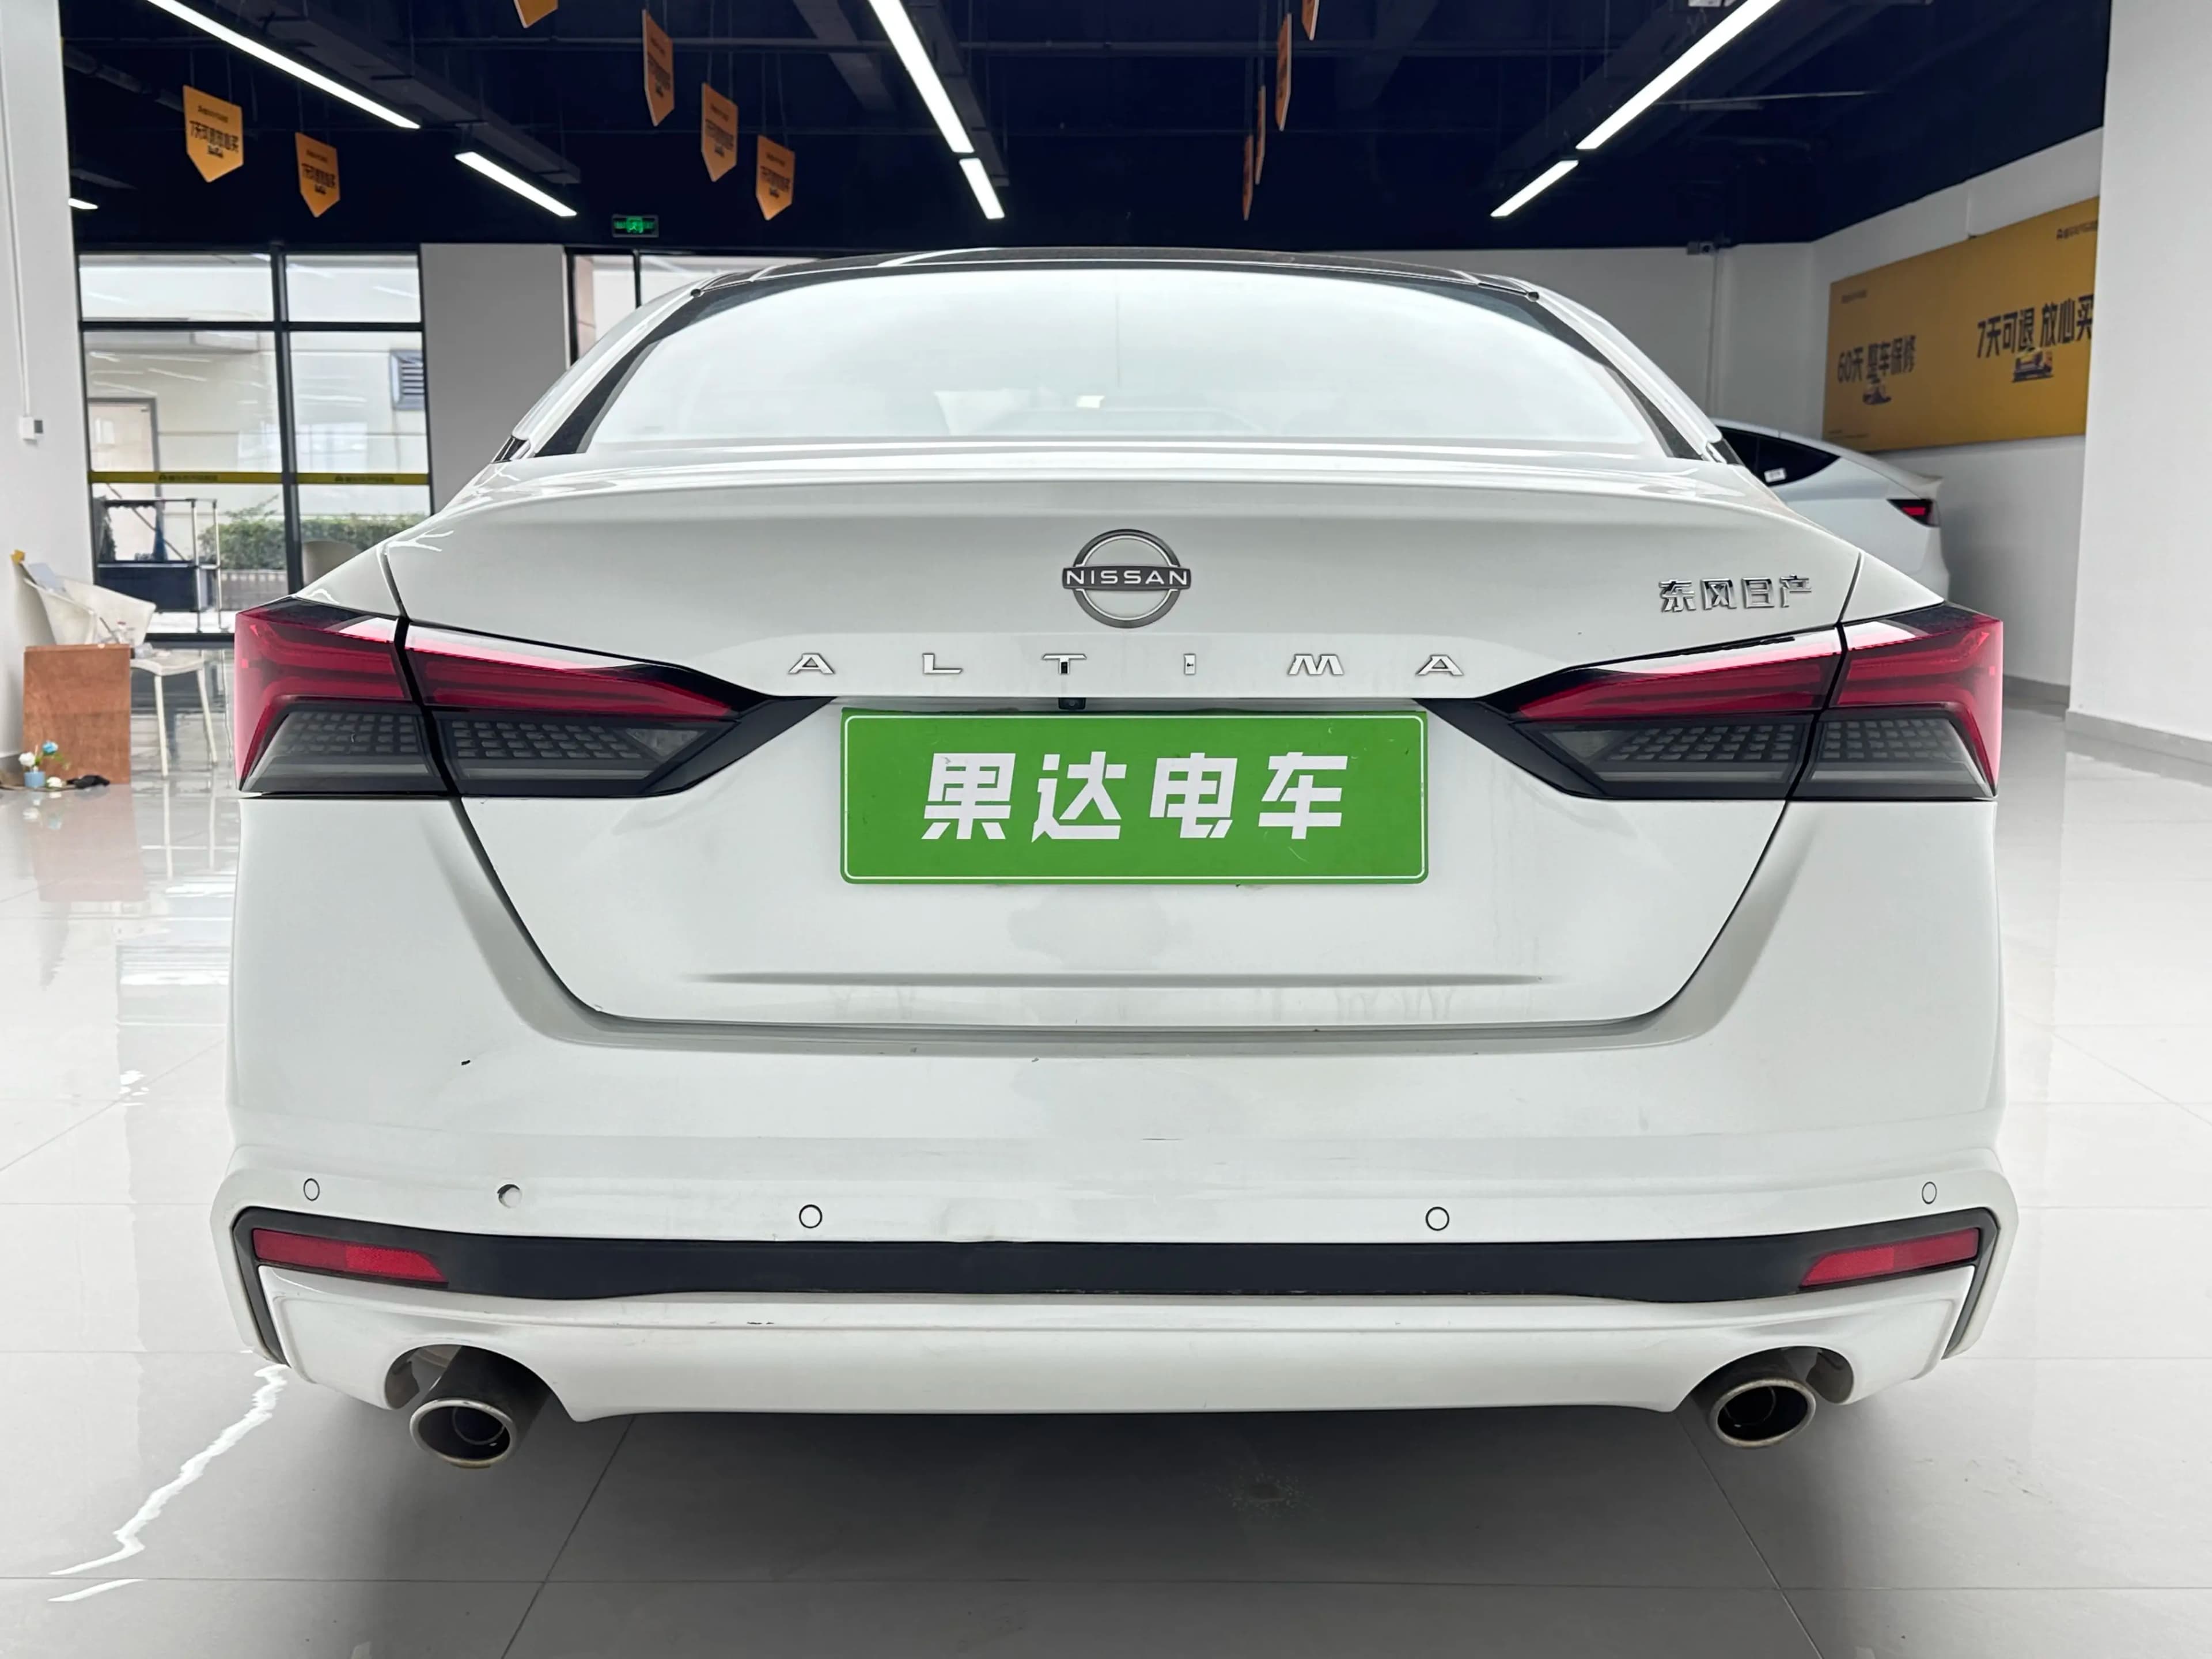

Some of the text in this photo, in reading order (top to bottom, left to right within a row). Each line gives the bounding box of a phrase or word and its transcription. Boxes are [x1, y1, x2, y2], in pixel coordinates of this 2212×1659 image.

[1977, 294, 2094, 358] 7天可退 放心买
[1838, 334, 1916, 384] 60天 整车保修
[1066, 568, 1187, 586] NISSAN
[1659, 574, 1812, 612] 东风日产
[788, 652, 1465, 676] ALTIMA
[921, 751, 1348, 843] 果达电车
